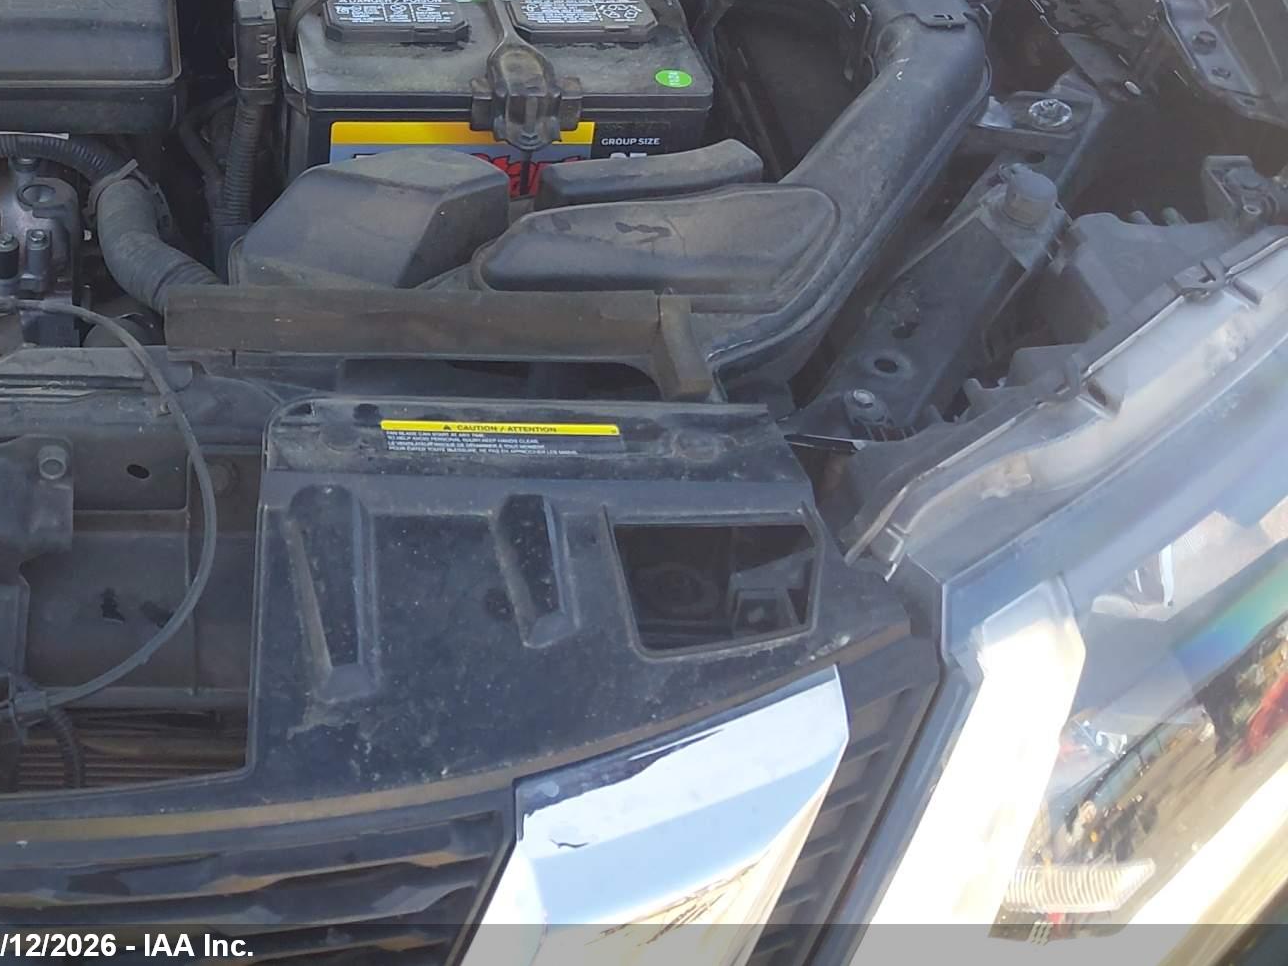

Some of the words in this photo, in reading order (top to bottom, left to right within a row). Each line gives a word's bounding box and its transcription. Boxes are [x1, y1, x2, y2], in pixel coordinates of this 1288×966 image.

[601, 138, 637, 146] GROUP
[638, 137, 661, 146] SIZE
[457, 424, 497, 432] CAUTION
[507, 425, 557, 434] ATTENTION
